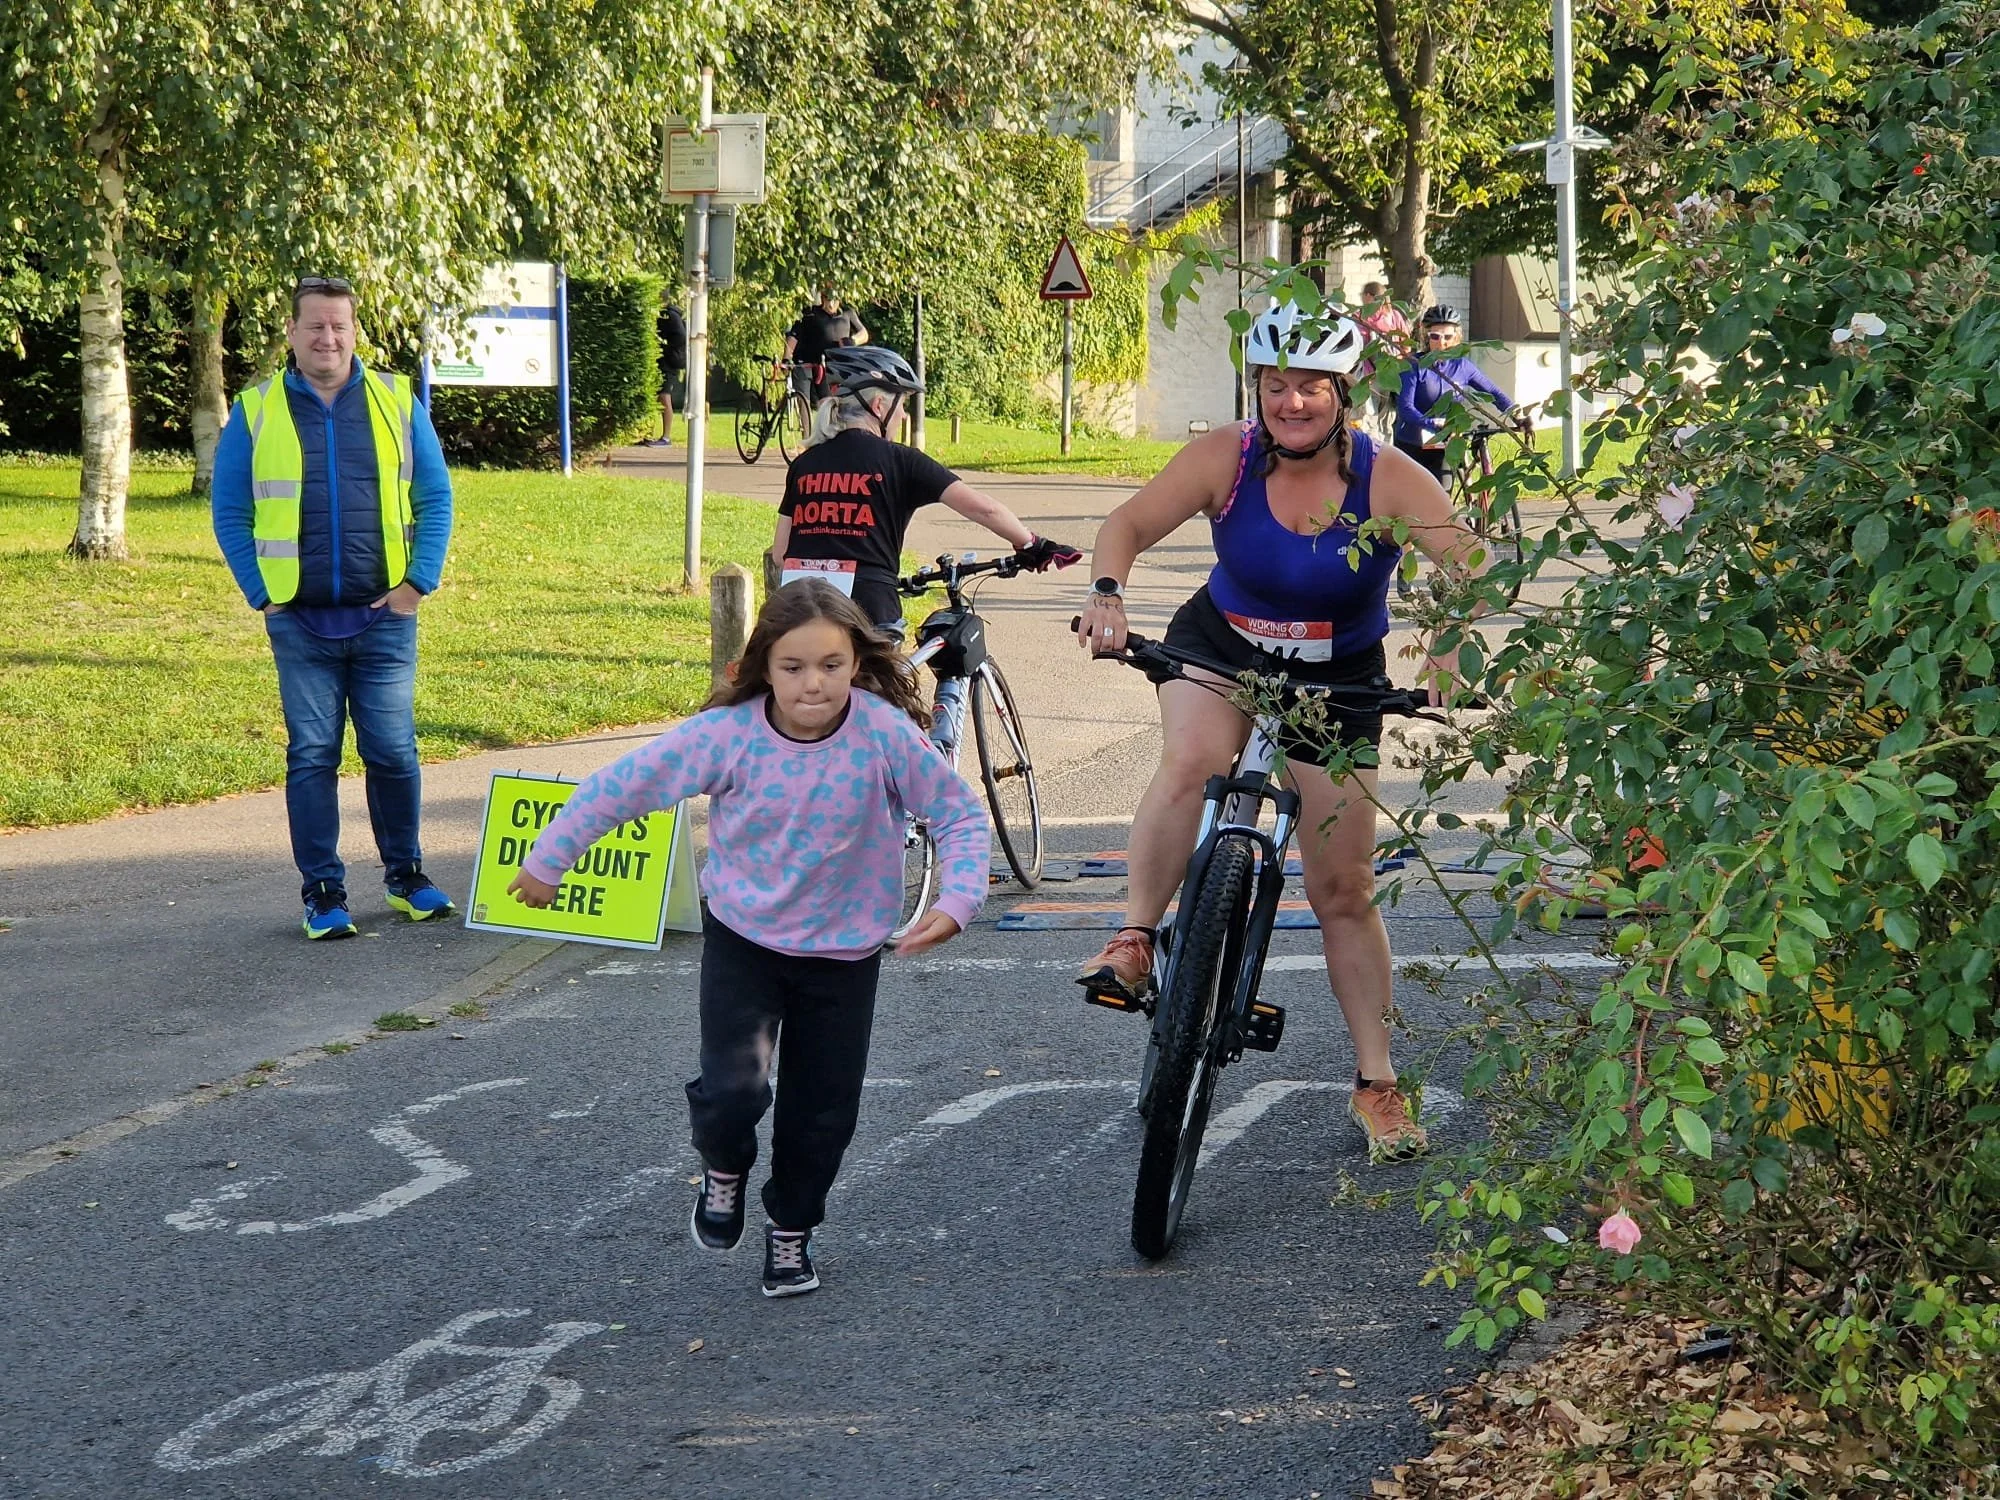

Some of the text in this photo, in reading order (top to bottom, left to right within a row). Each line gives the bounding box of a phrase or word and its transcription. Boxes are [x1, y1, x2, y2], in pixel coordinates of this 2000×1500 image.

[793, 501, 875, 526] AORTA
[1248, 618, 1287, 633] WOKING
[1248, 626, 1287, 637] TRIATHLON
[534, 883, 606, 916] ERE
